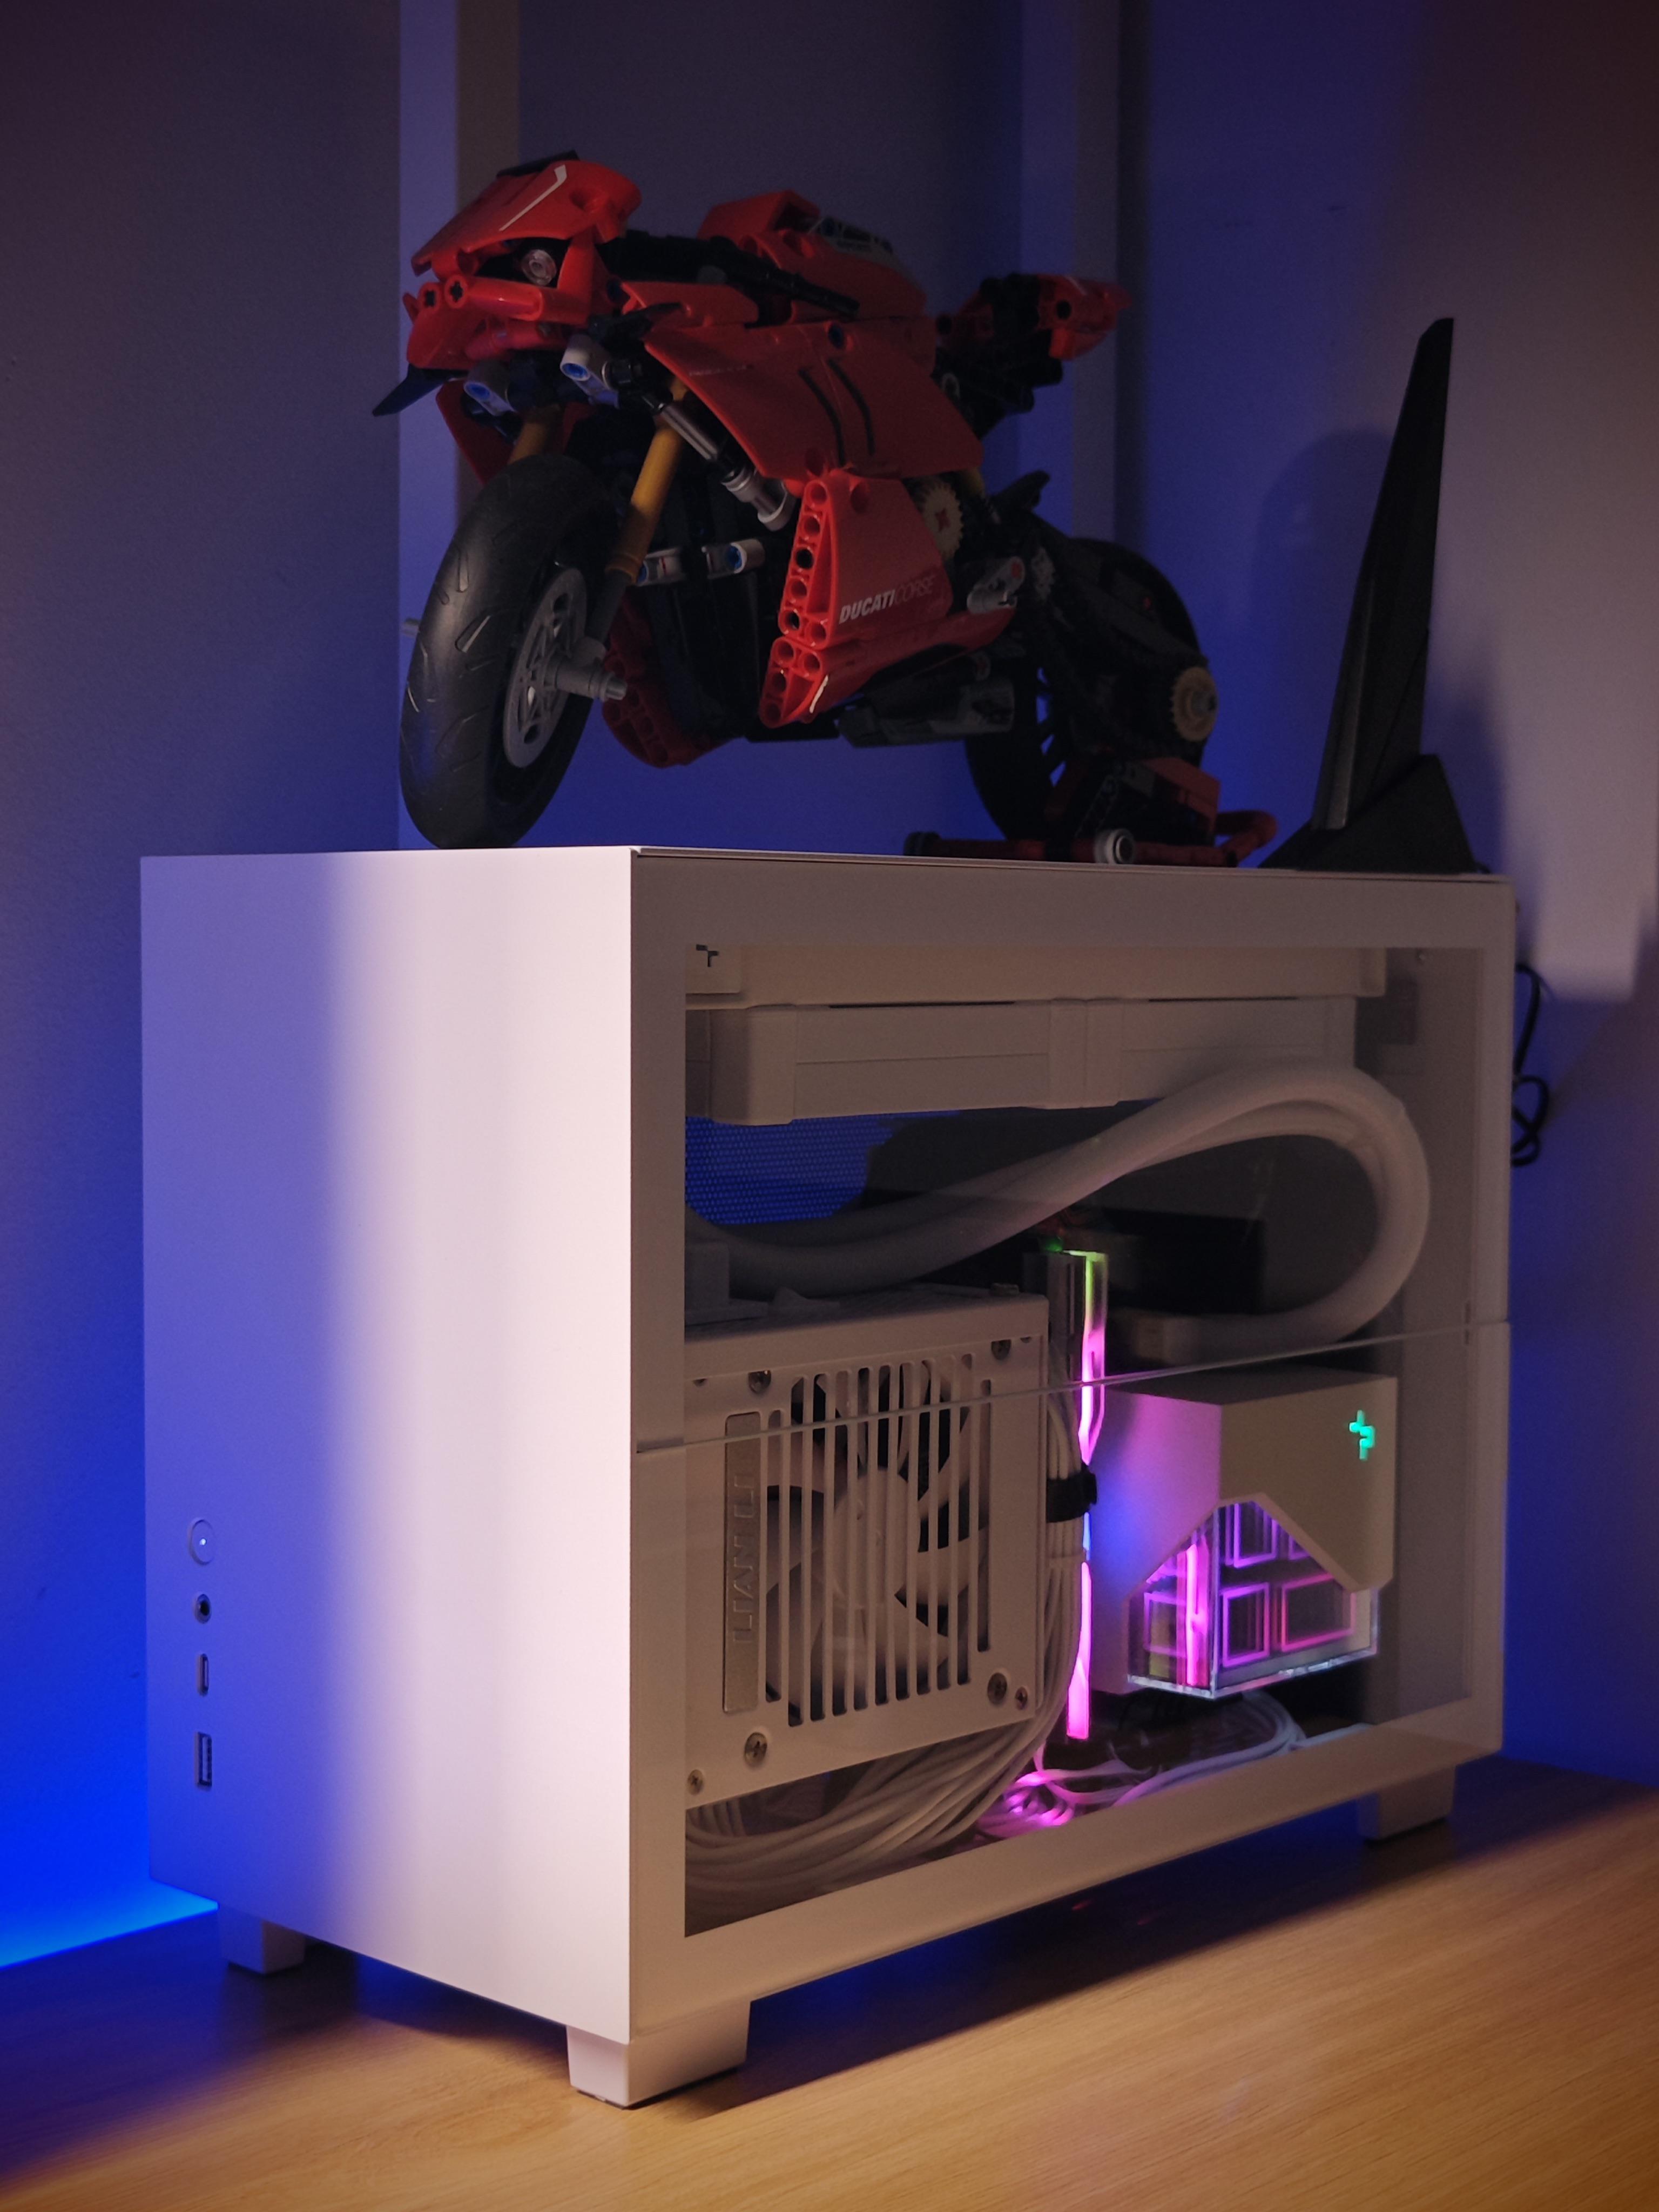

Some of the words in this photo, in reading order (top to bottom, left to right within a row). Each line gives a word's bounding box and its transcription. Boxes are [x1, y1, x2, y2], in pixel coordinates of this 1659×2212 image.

[839, 589, 896, 625] DUCATI
[733, 1475, 755, 1519] LI
[732, 1535, 754, 1643] LIAN
